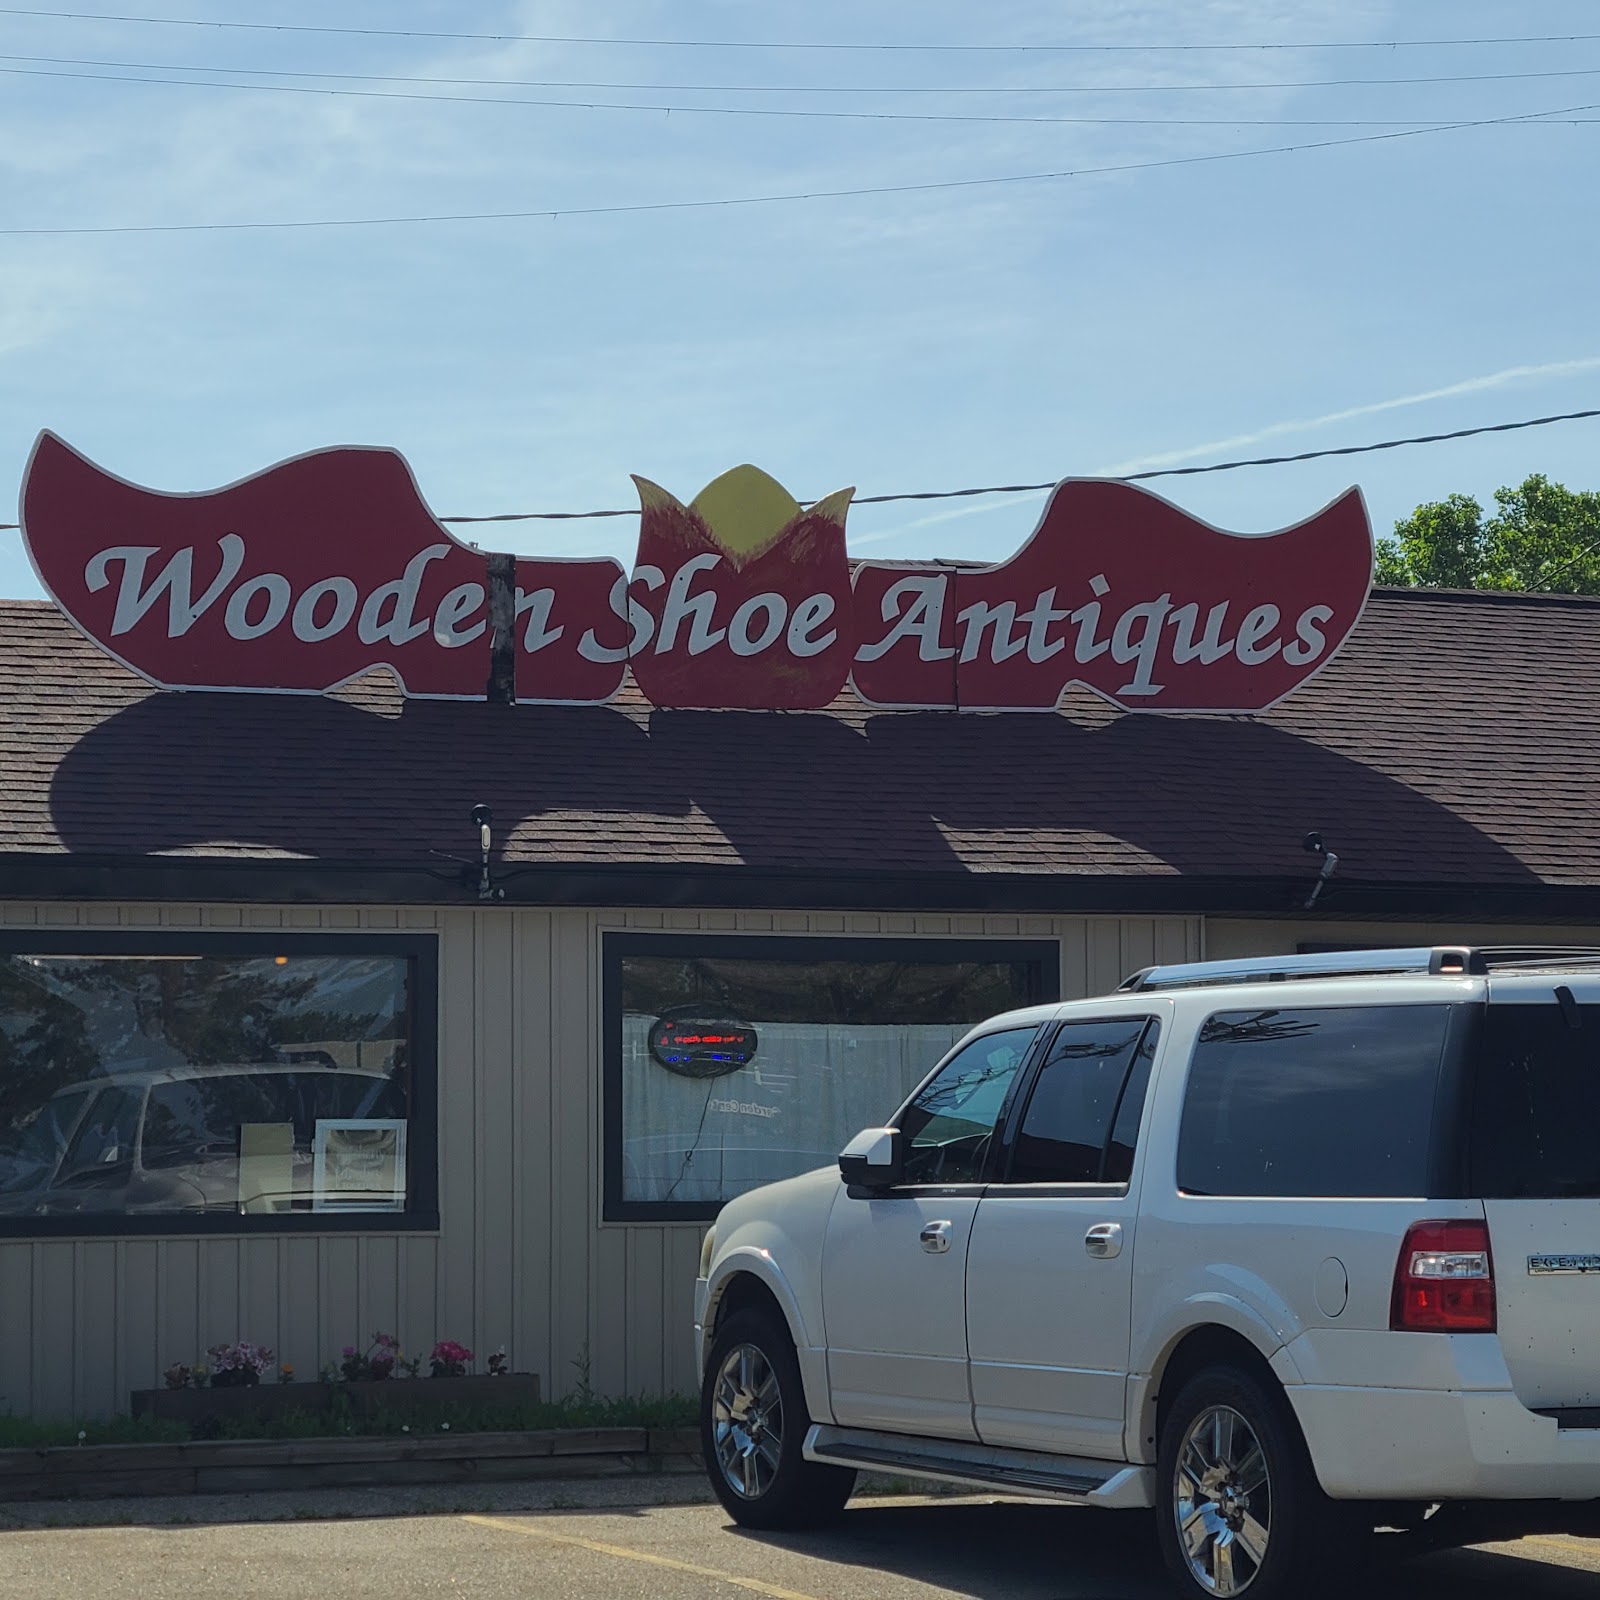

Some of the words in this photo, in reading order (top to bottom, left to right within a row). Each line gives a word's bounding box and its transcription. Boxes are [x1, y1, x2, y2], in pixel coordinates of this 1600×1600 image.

[84, 532, 564, 654] Wooden
[577, 552, 837, 663] Shoe
[854, 573, 1334, 695] Antiques
